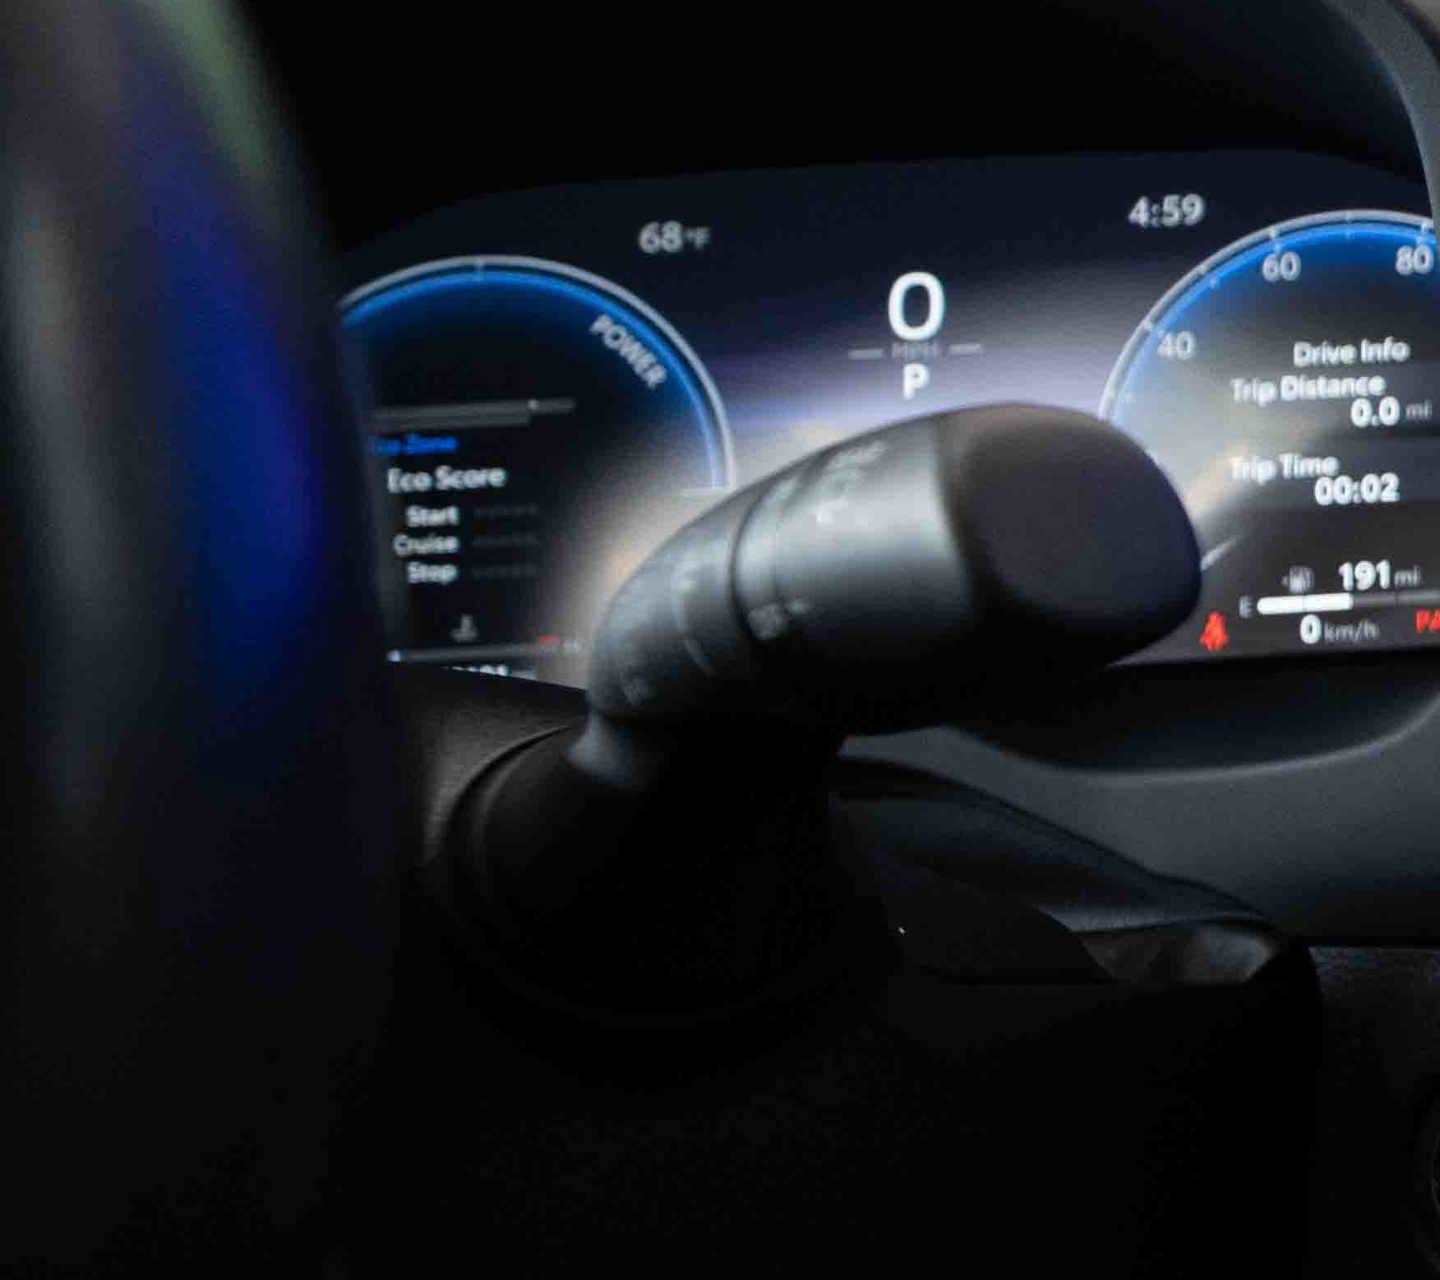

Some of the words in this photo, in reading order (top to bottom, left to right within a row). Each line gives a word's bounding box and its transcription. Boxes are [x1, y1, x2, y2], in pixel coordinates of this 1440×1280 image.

[1128, 194, 1205, 228] 4:59
[1262, 251, 1300, 282] 60
[1395, 245, 1432, 275] 80
[888, 271, 945, 341] 0
[589, 314, 667, 389] POWER
[1157, 330, 1195, 358] 40
[1293, 341, 1355, 367] Drive
[1360, 338, 1410, 363] Info
[902, 363, 930, 399] P
[1232, 379, 1274, 404] Trip
[1280, 373, 1385, 398] Distance
[1351, 397, 1400, 427] 0.0
[1405, 401, 1431, 420] mi
[387, 467, 432, 493] Eco
[435, 465, 507, 490] Score
[1231, 456, 1273, 482] Trip
[1278, 454, 1338, 477] Time
[1315, 473, 1399, 505] 00:02
[405, 505, 460, 527] Start
[393, 533, 461, 557] Cruise
[406, 562, 458, 586] Stop
[1338, 560, 1390, 591] 191
[1394, 566, 1420, 587] mi
[1239, 596, 1254, 618] E
[1300, 614, 1322, 644] 0
[1324, 620, 1380, 642] km/h
